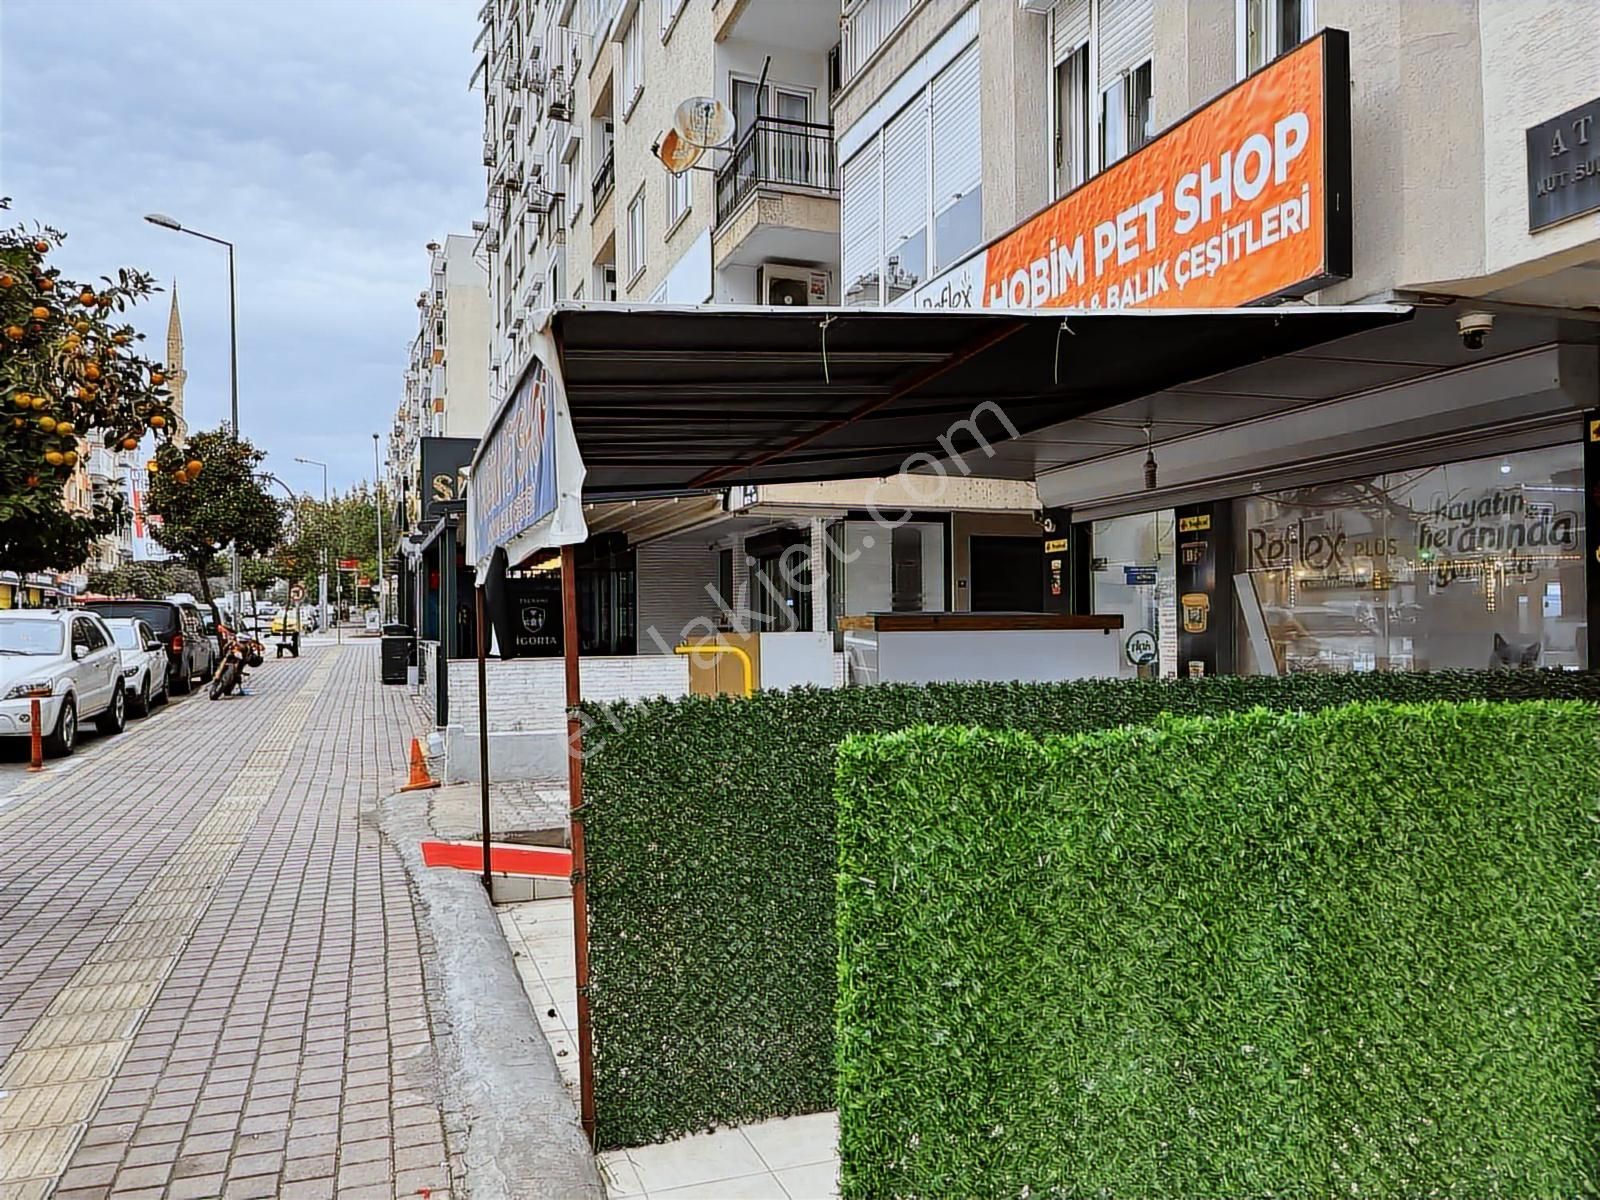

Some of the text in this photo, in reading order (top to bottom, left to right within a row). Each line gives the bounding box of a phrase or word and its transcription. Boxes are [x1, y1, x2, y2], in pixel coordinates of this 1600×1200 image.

[990, 111, 1309, 308] HOBİM PET SHOP
[1107, 259, 1169, 308] BALIK
[1174, 184, 1310, 291] ÇEŞİTLERİ
